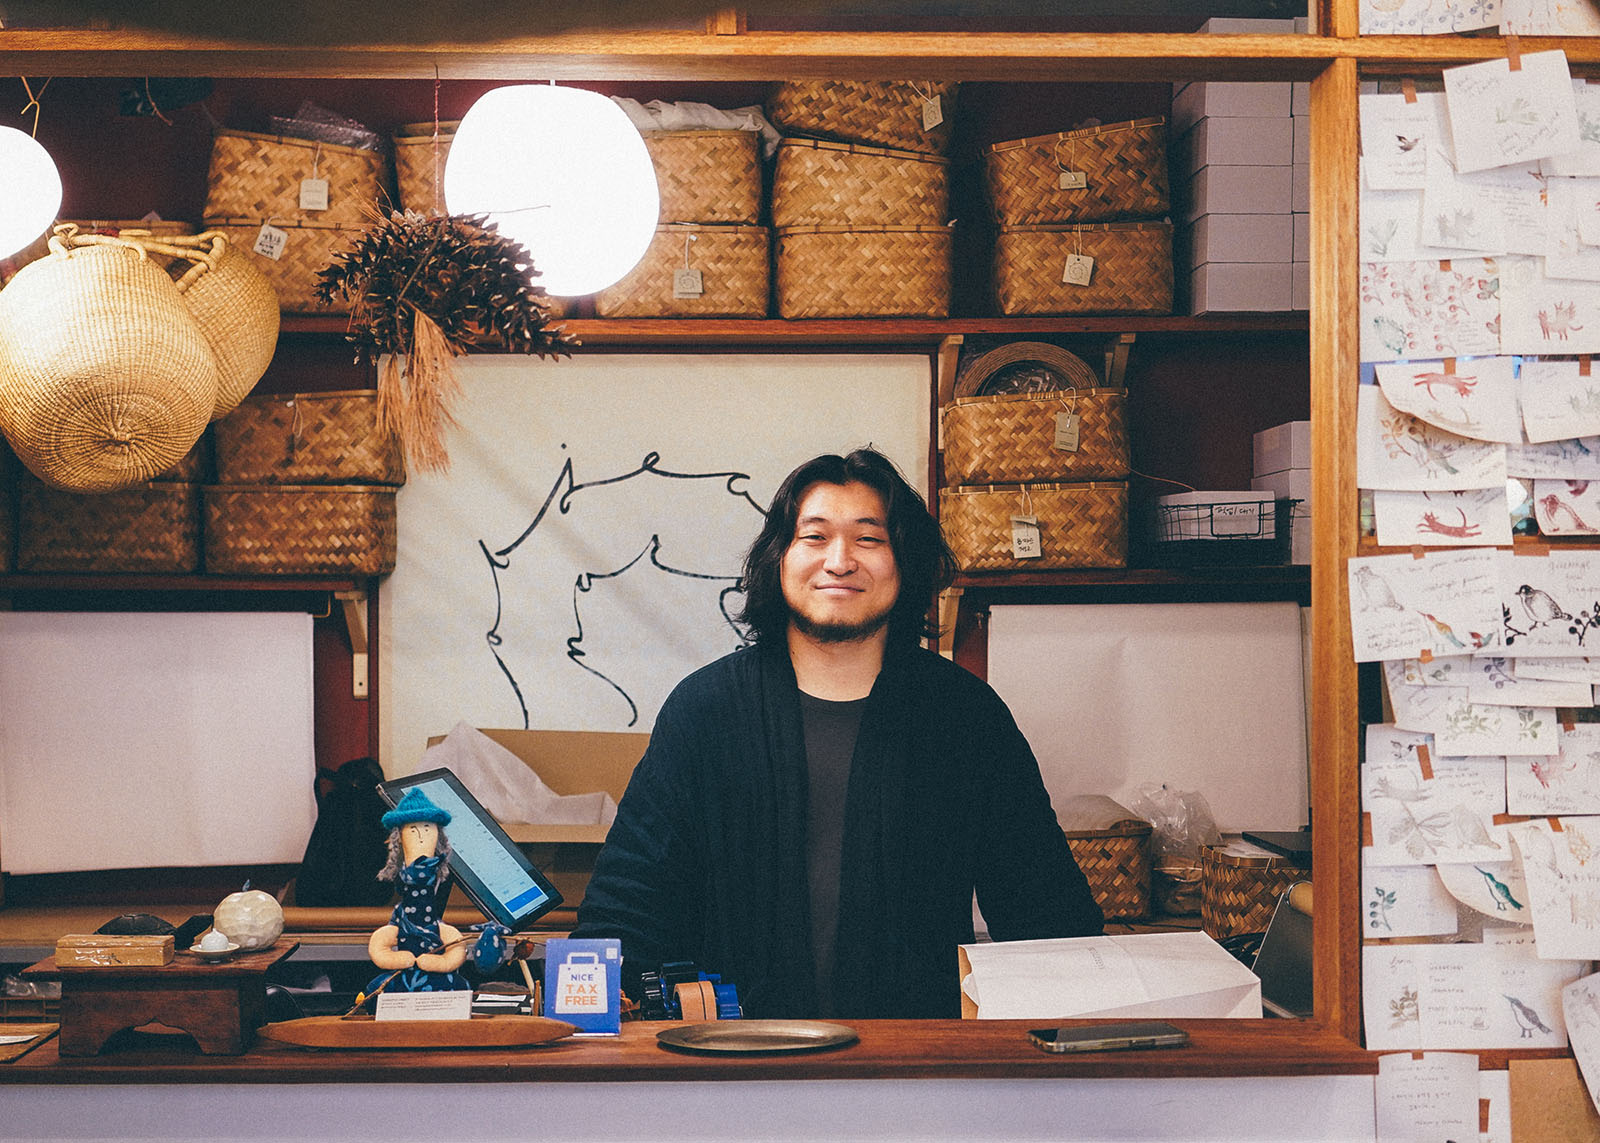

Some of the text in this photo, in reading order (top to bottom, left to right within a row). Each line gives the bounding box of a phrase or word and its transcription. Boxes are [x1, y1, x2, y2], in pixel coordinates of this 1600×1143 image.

[570, 973, 595, 982] NICE
[565, 983, 599, 995] TAX
[564, 995, 599, 1006] FREE
